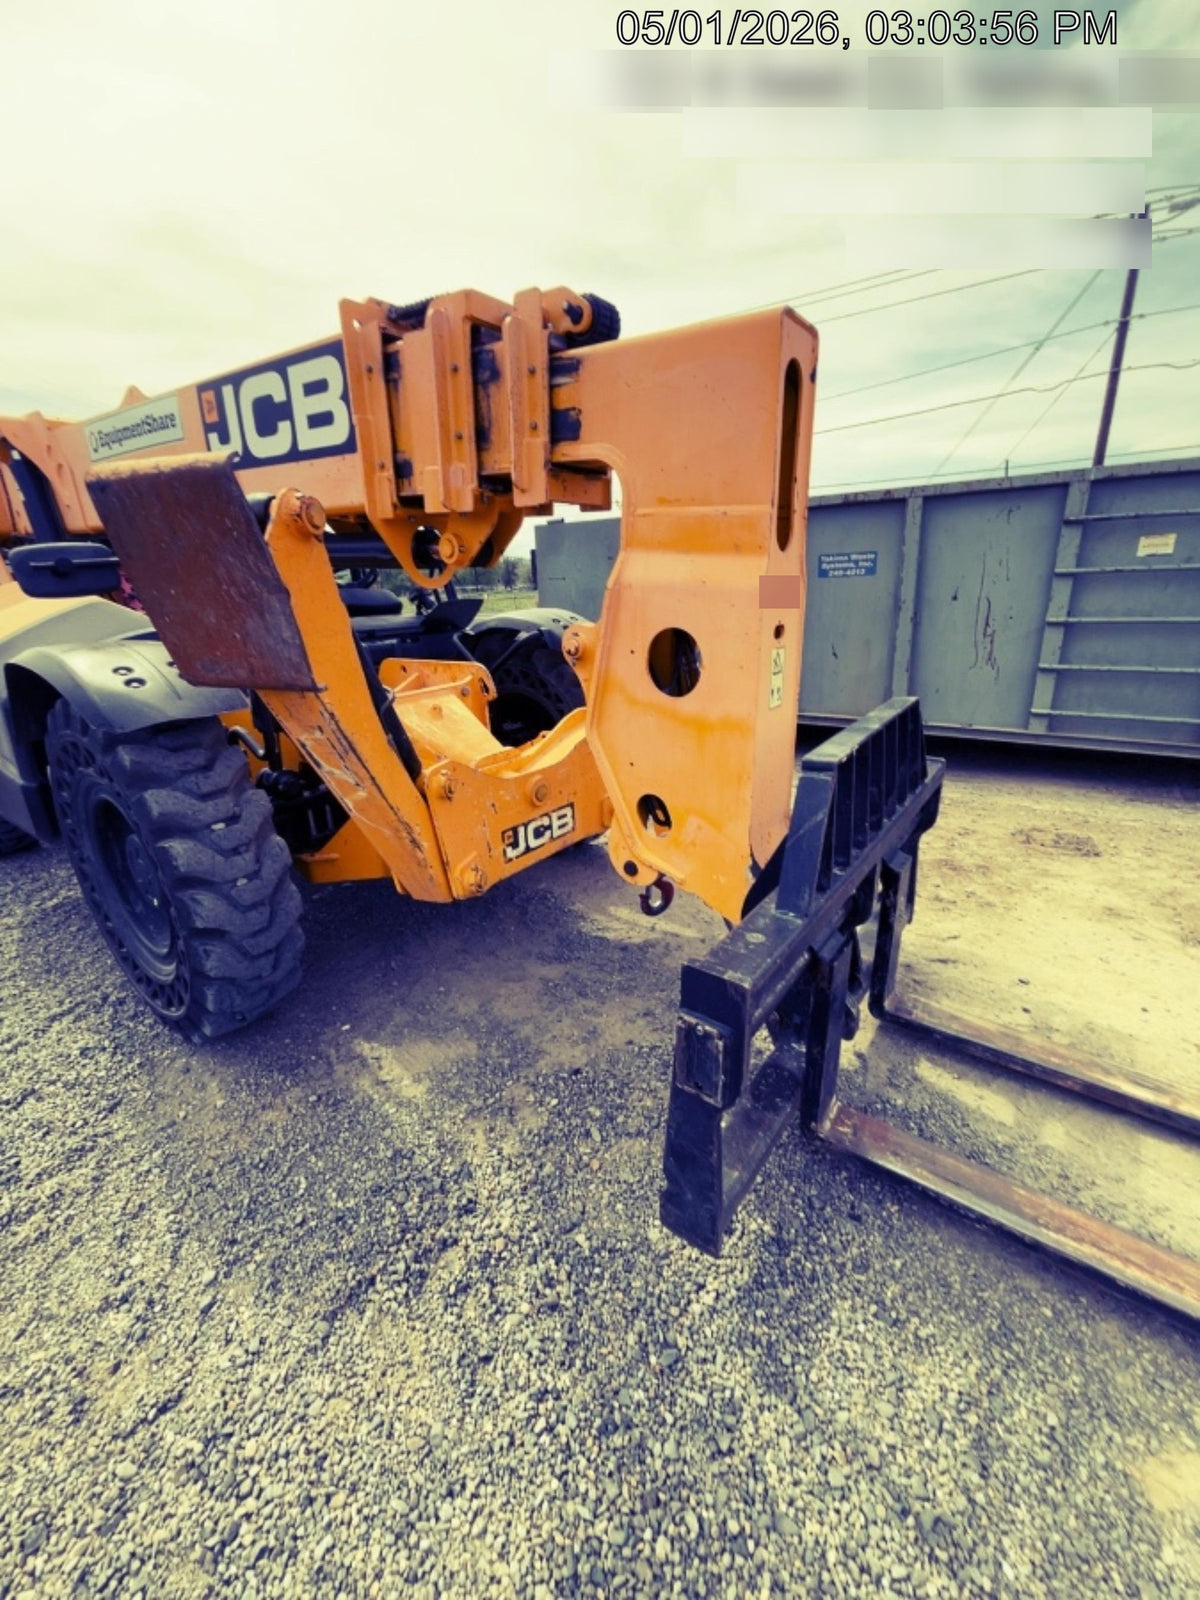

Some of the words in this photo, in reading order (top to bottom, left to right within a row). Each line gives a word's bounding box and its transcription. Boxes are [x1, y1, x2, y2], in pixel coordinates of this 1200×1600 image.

[98, 413, 177, 450] EquipmentShare
[207, 355, 351, 459] JCB
[505, 806, 574, 860] JCB
